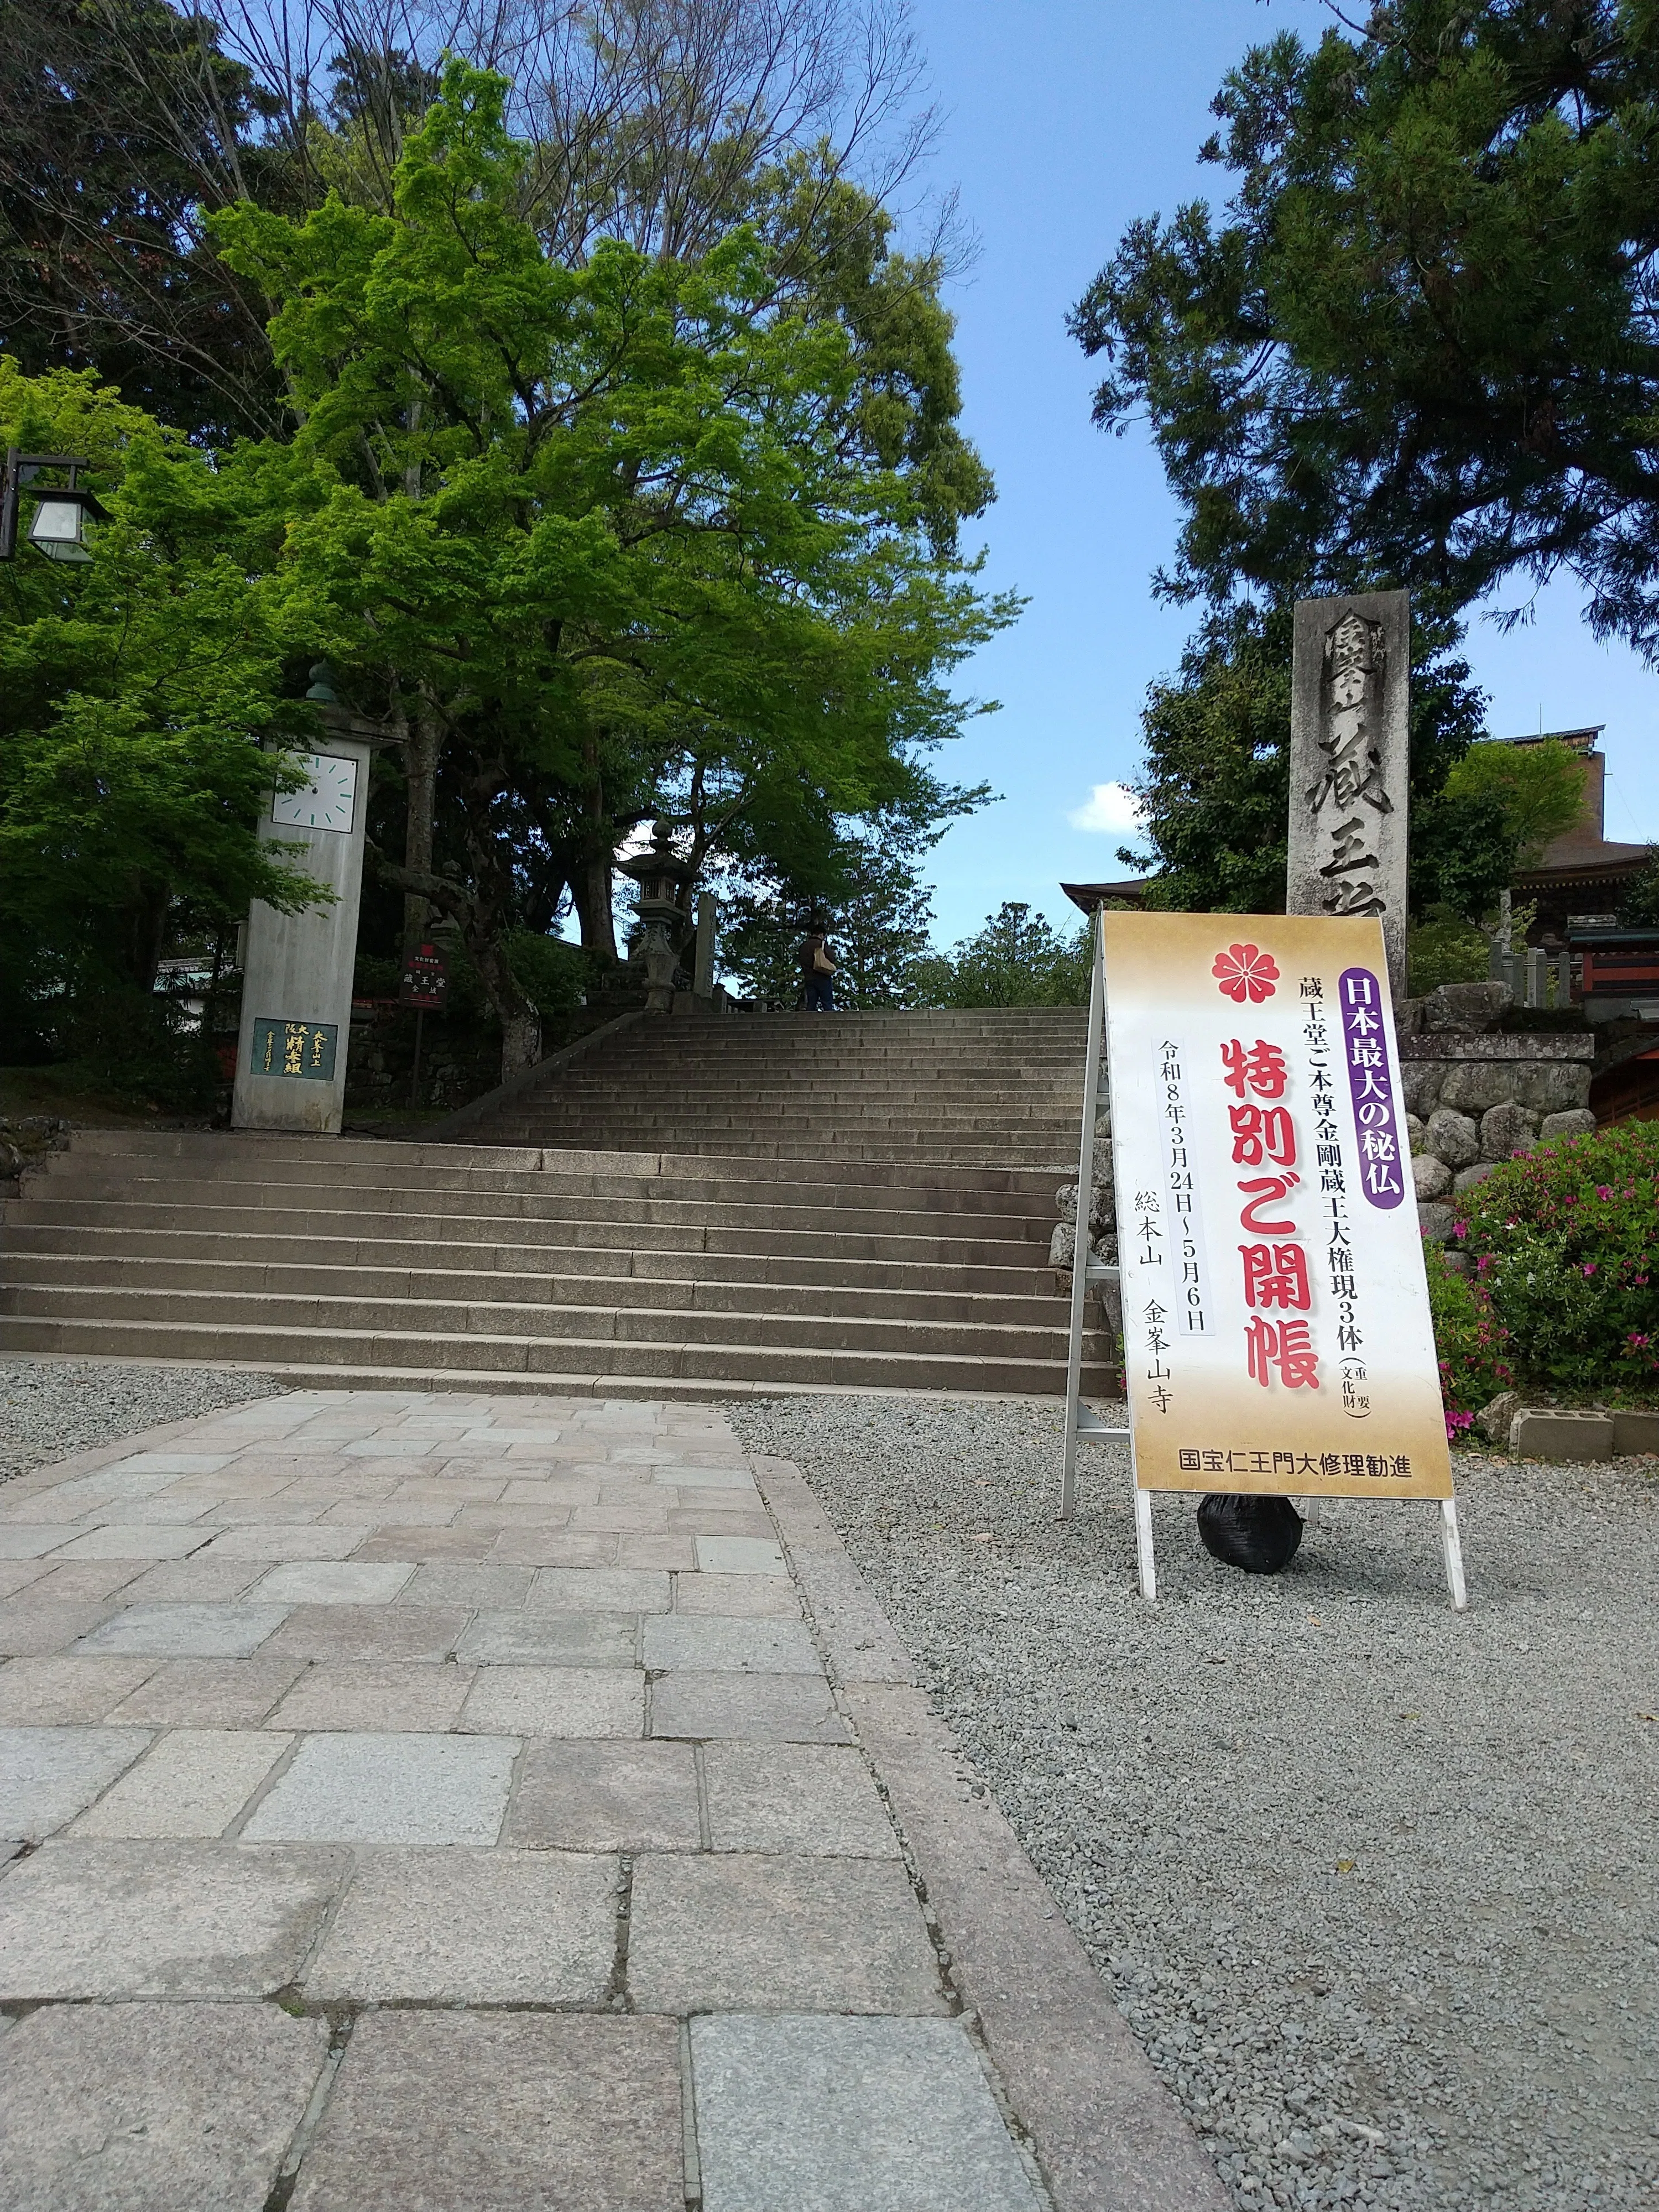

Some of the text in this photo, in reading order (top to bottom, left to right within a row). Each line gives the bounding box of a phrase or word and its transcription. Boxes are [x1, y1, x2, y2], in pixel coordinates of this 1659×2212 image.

[285, 1023, 310, 1035] 大阪
[404, 973, 446, 988] 蔵王堂
[1345, 977, 1400, 1195] 日本最大の秘仏
[1219, 1039, 1320, 1390] 特別ご開帳
[1297, 976, 1364, 1353] 蔵王堂ご本尊金剛蔵王大権現3体
[1134, 1190, 1174, 1415] 総本山 金峯山寺
[1178, 1448, 1412, 1479] 国宝仁王門大修理勧進
